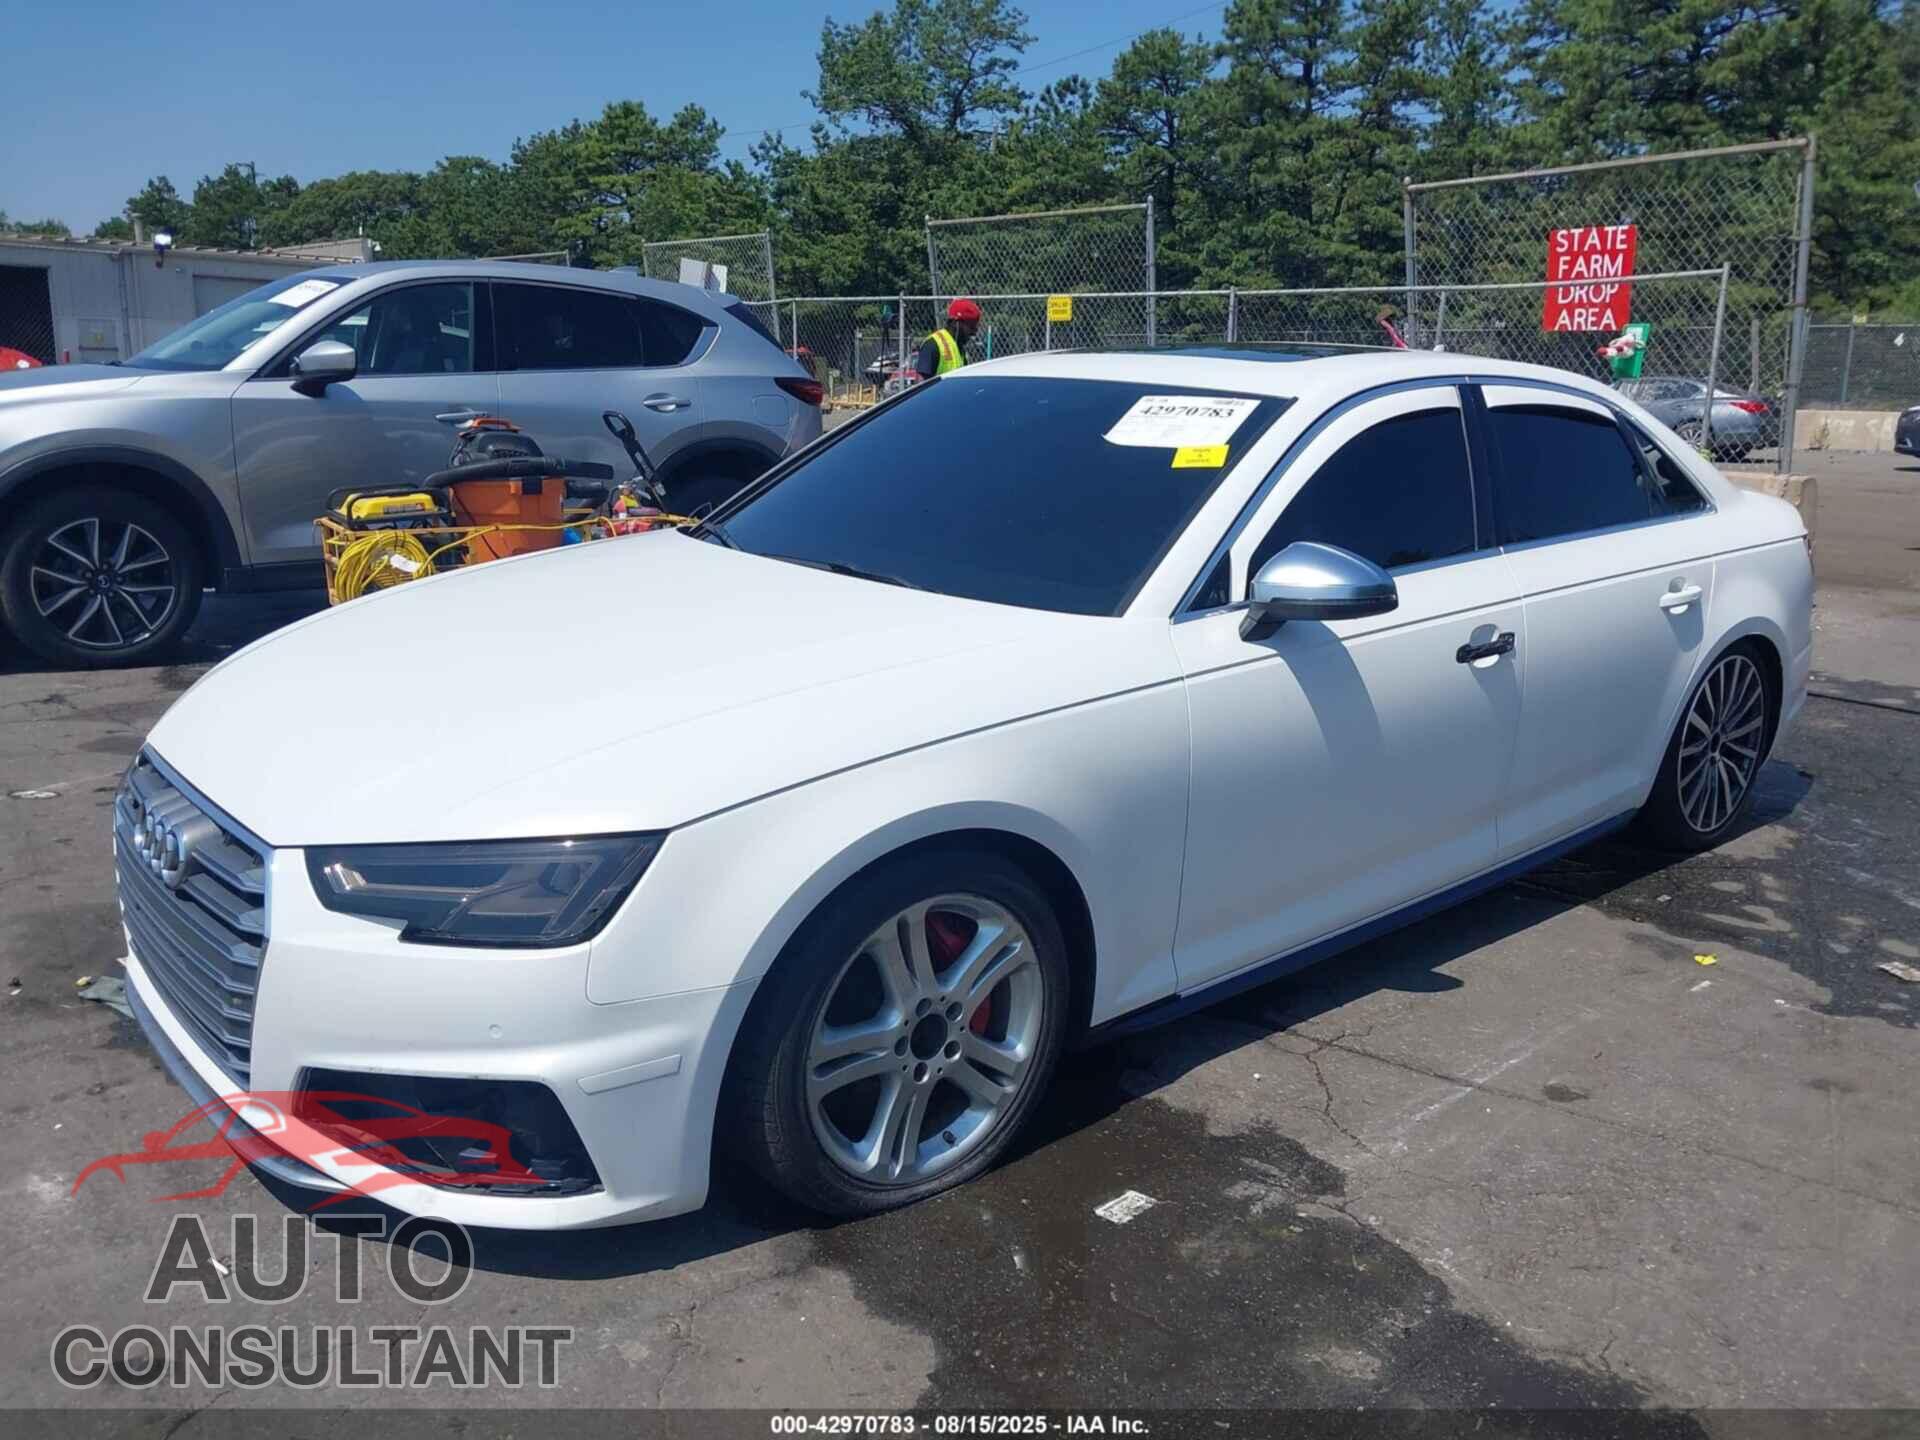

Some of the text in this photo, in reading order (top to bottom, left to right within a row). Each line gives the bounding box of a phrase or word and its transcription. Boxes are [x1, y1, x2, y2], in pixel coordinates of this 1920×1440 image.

[1555, 224, 1629, 252] STATE
[1558, 253, 1624, 279] FARM
[1557, 283, 1619, 304] DROP
[1554, 307, 1617, 331] AREA
[1140, 405, 1235, 418] 42970783
